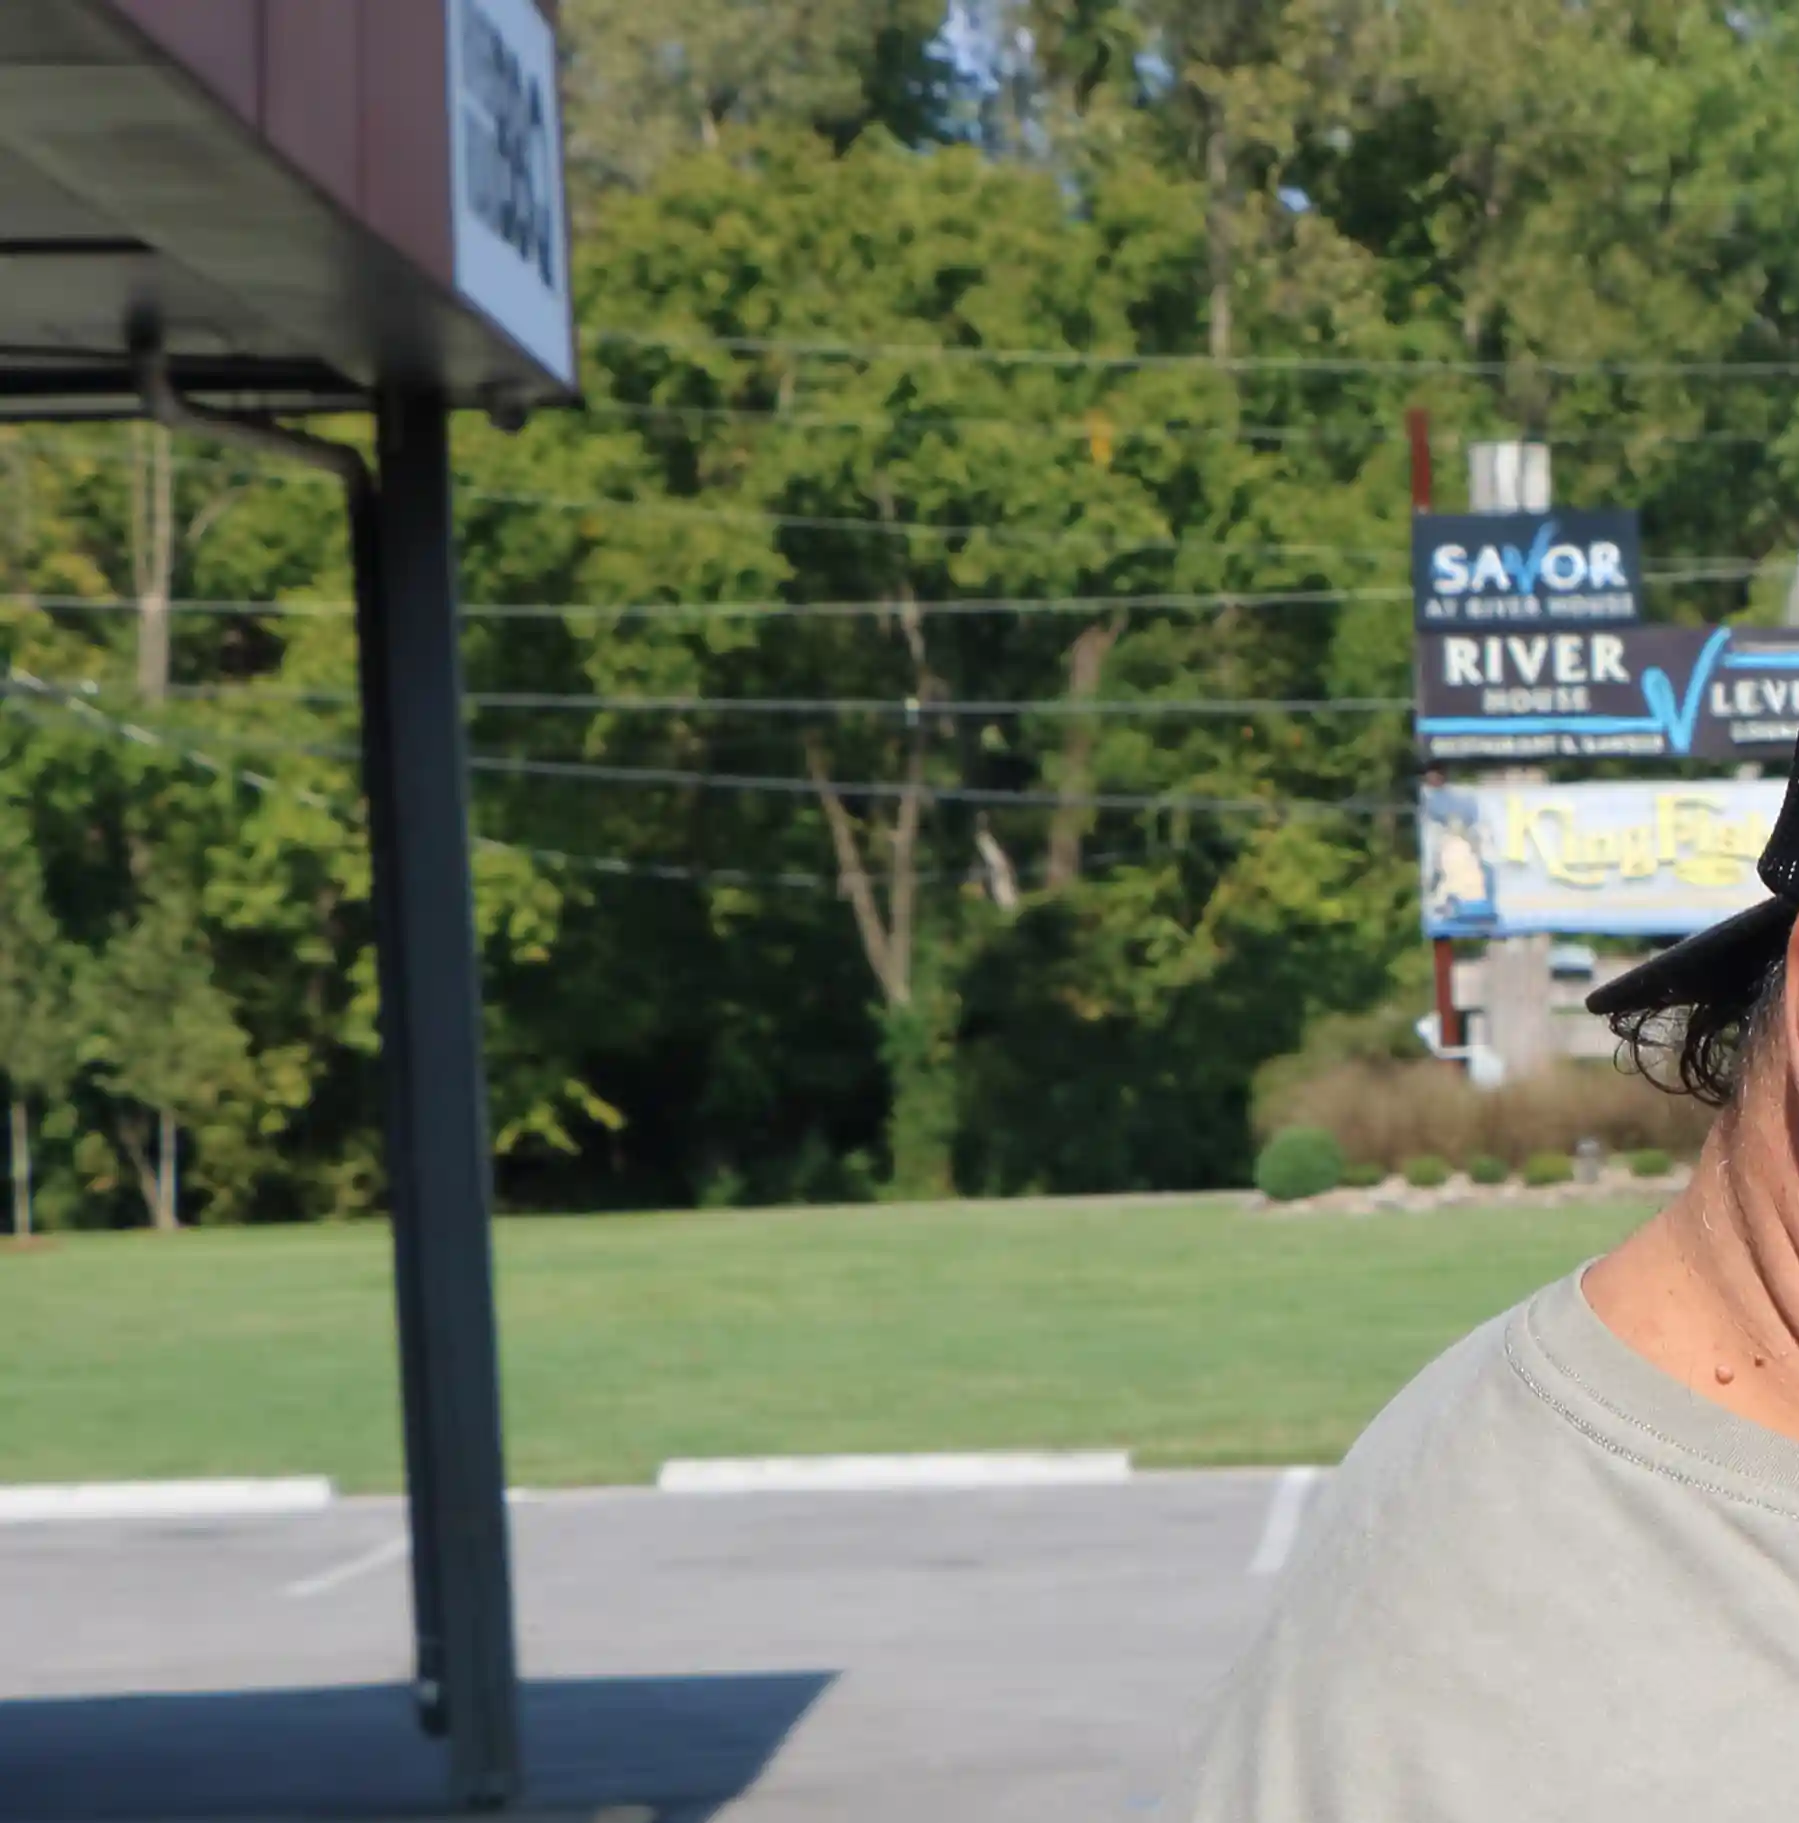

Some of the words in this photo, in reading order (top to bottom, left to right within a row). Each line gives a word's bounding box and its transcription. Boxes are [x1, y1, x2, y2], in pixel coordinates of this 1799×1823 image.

[1432, 522, 1627, 595] SAVOR
[1443, 634, 1630, 686] RIVER
[1483, 687, 1592, 713] HOUSE
